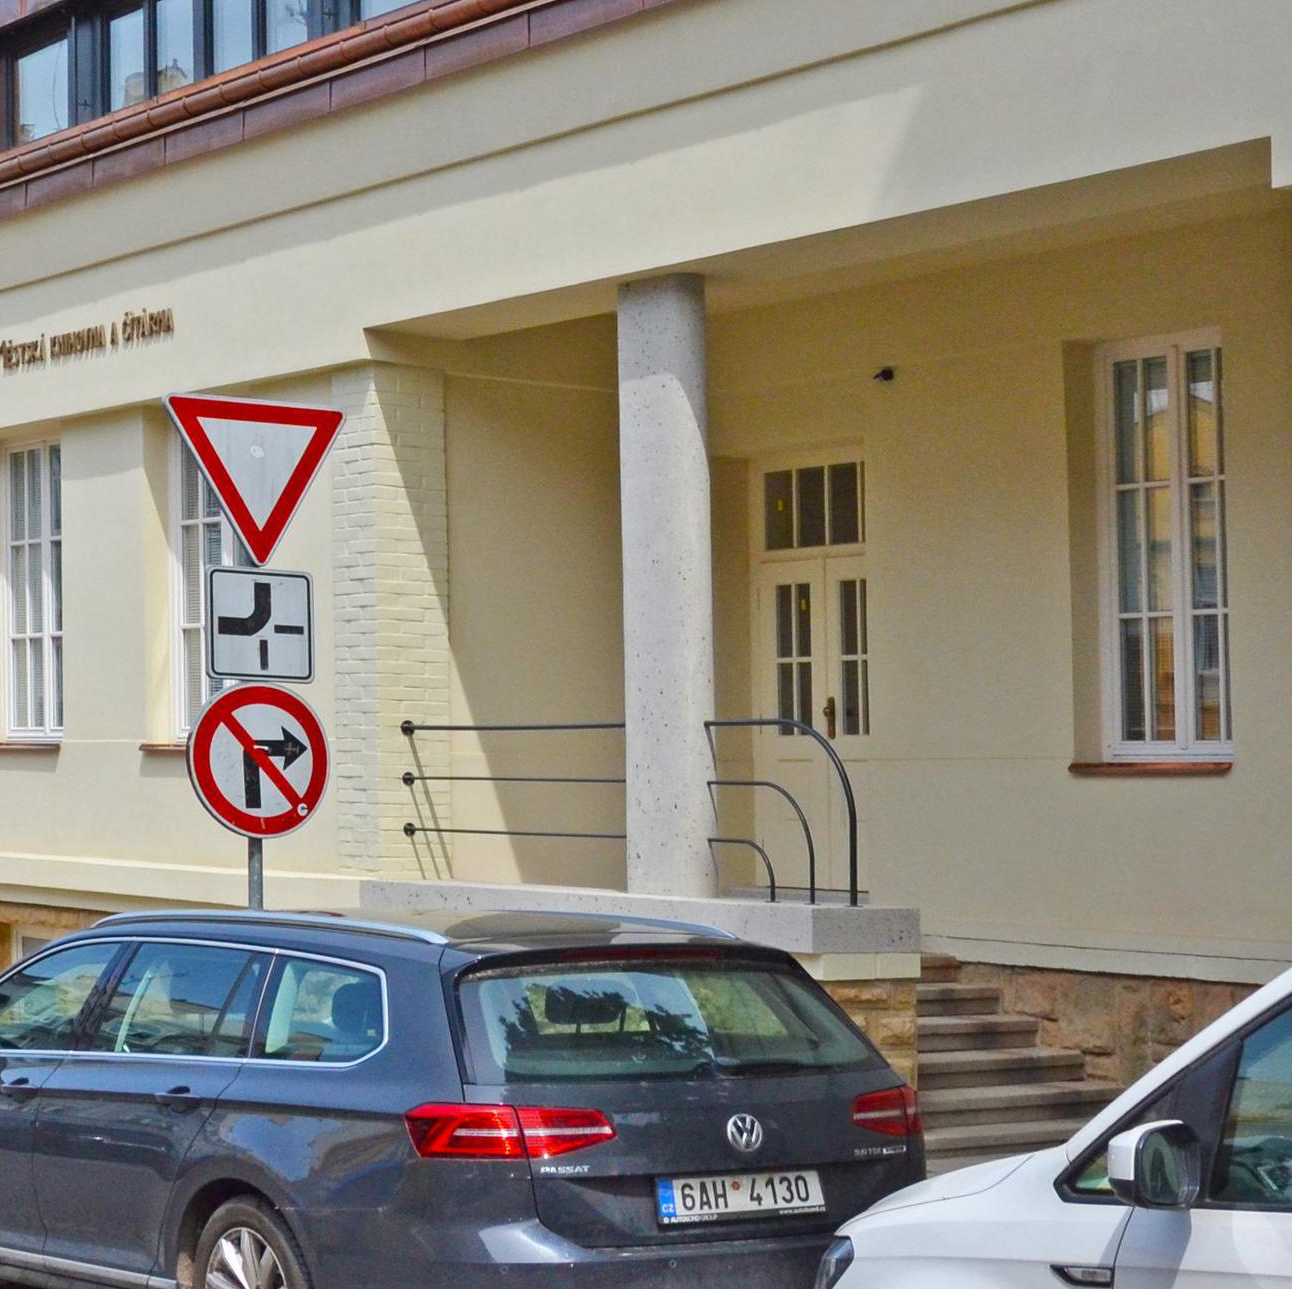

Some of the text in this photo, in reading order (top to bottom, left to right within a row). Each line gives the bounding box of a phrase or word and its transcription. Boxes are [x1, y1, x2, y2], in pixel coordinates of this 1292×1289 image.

[540, 1165, 590, 1174] PASSAT
[680, 1175, 810, 1211] 6AH 4130
[662, 1203, 675, 1213] CZ
